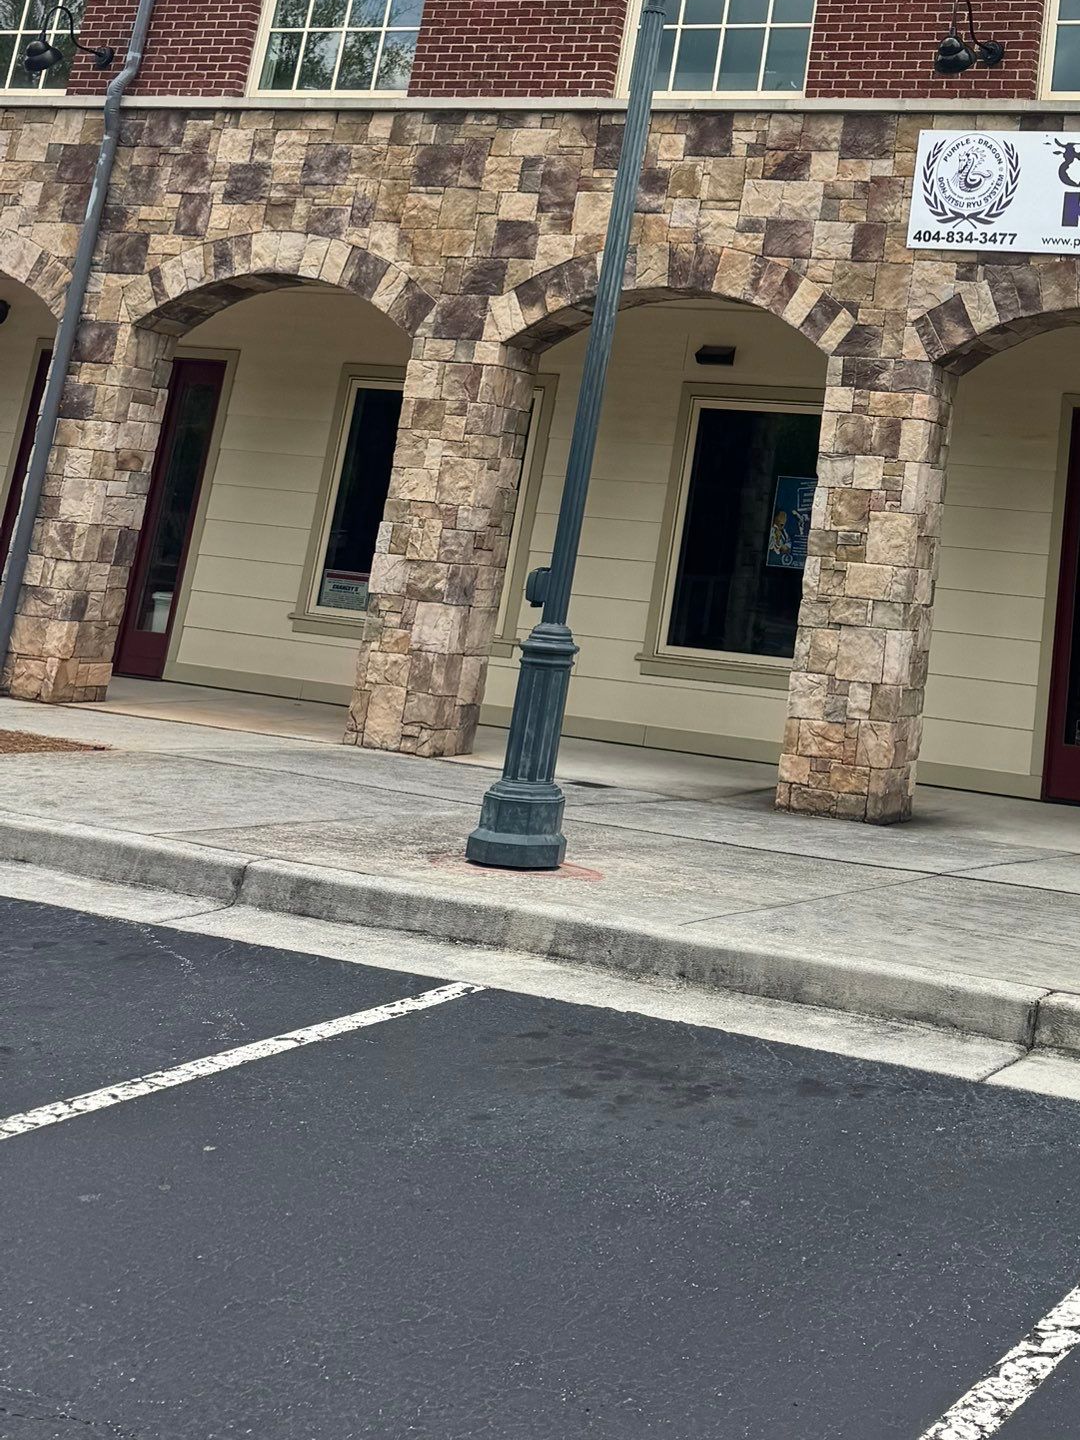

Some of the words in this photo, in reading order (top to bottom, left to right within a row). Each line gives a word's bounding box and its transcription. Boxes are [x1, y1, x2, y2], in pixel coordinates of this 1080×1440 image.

[943, 138, 971, 162] PURPLE
[978, 138, 1003, 165] DRAGON
[966, 200, 982, 209] RYU
[983, 174, 1004, 203] SYSTEM
[913, 229, 1018, 245] 404-834-3477
